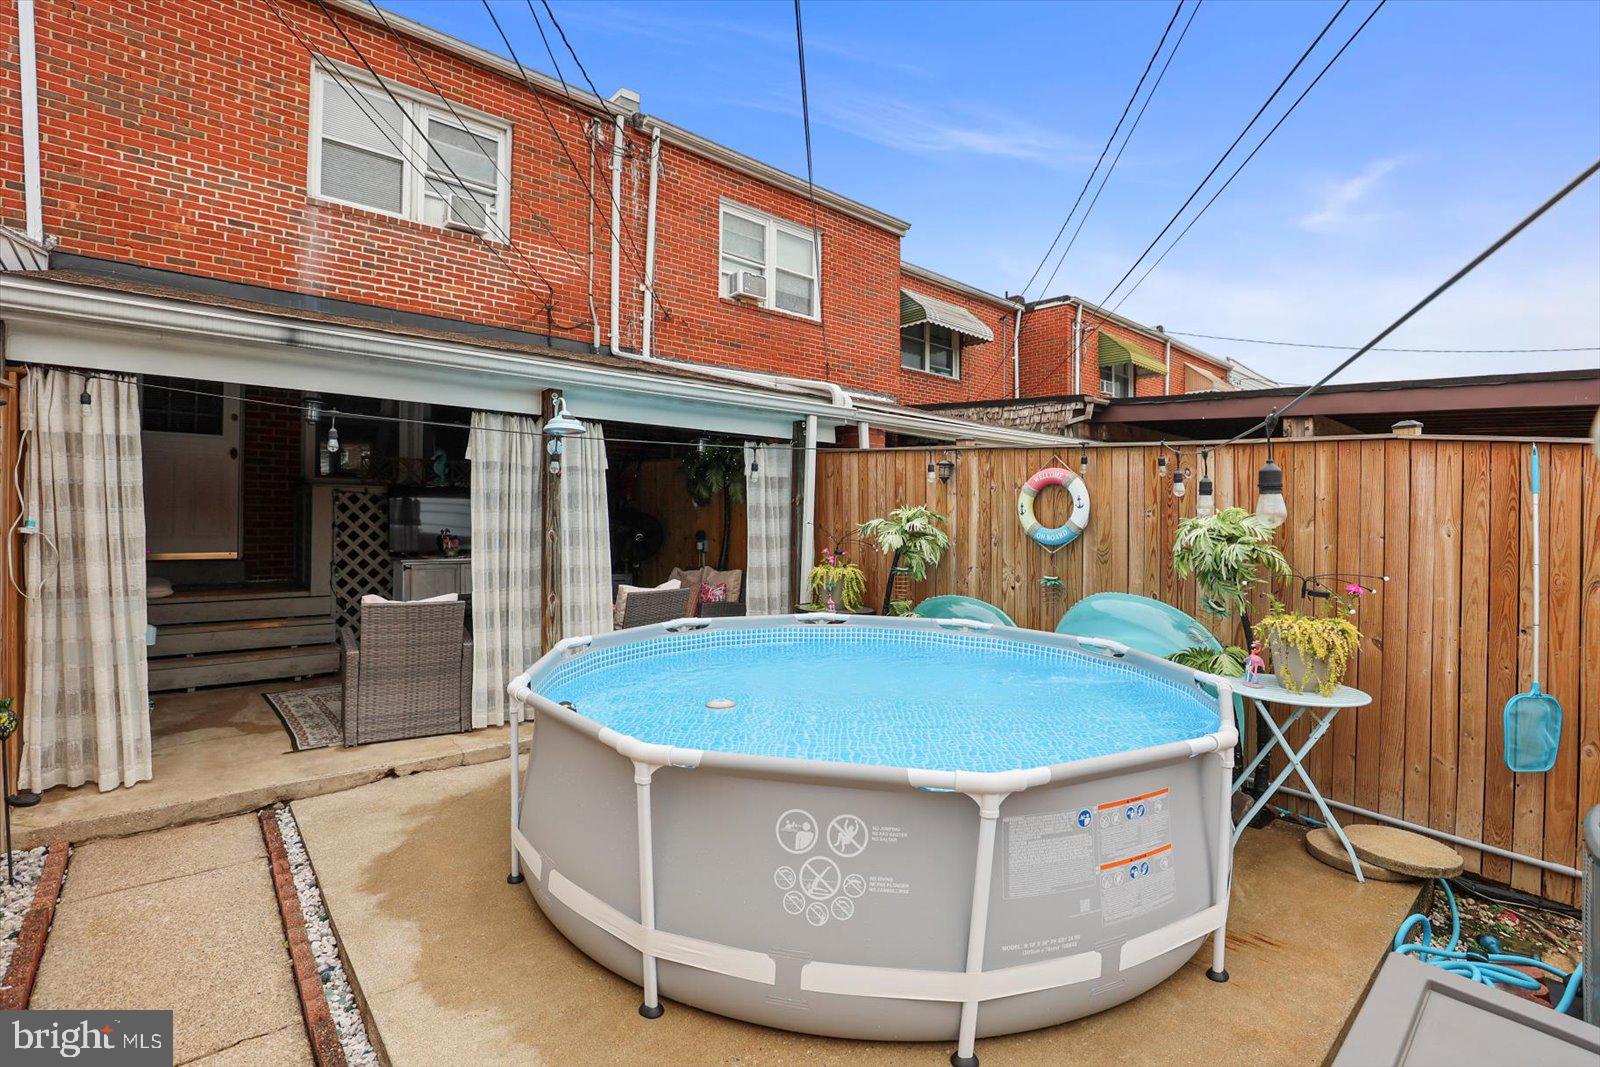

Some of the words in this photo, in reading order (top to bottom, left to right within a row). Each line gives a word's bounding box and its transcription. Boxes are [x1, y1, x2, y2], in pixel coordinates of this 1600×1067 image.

[1034, 471, 1064, 482] WELCOME
[1036, 532, 1046, 540] ON
[1046, 531, 1068, 541] BOARD
